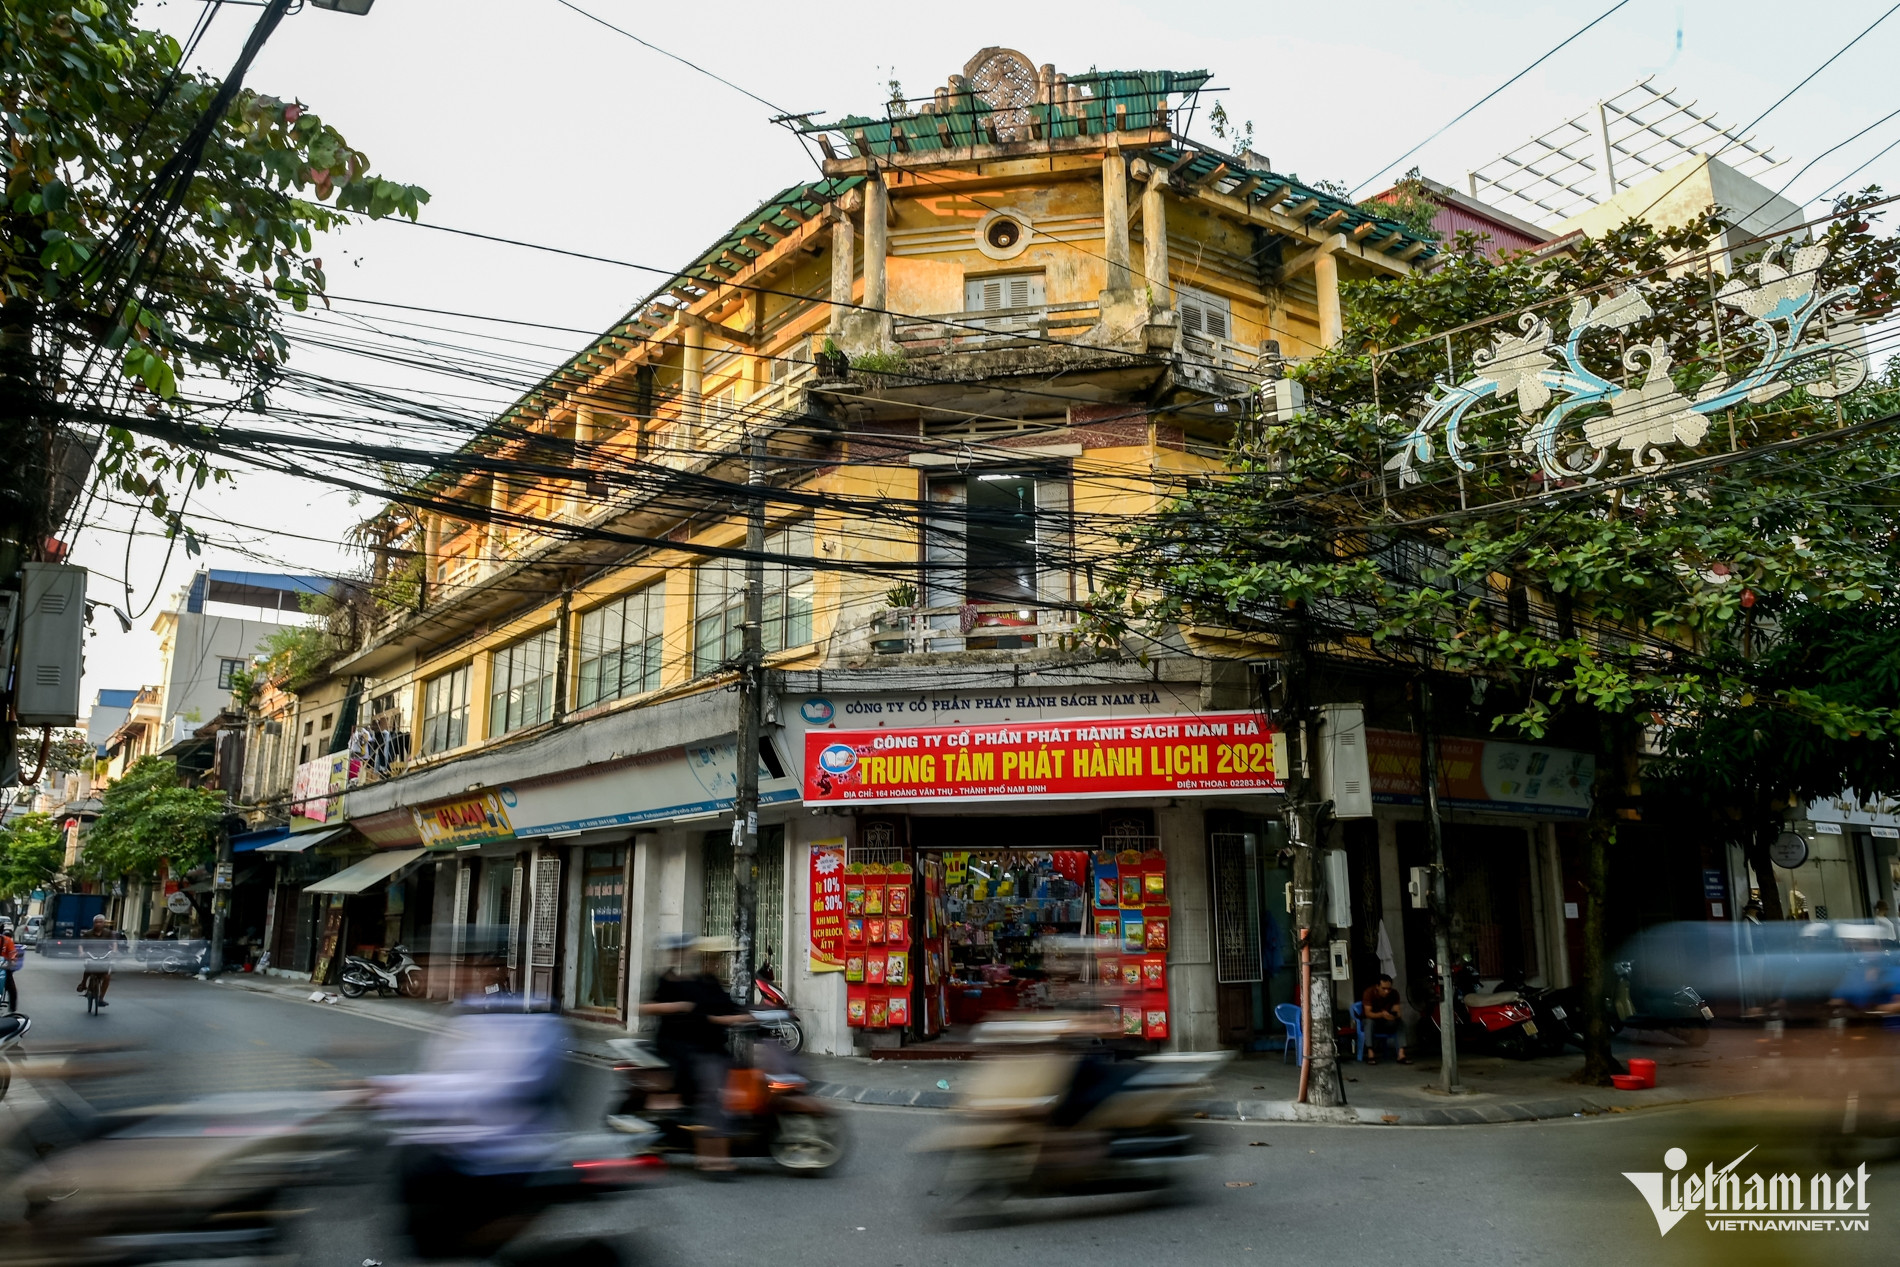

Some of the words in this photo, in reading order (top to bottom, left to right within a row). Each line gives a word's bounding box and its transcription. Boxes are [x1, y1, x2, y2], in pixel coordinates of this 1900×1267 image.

[846, 700, 882, 714] CÔNG
[886, 701, 904, 712] TY
[976, 695, 1012, 708] PHÁT
[1016, 694, 1056, 708] HÀNH
[1061, 693, 1097, 706] SÁCH
[1102, 694, 1134, 706] NAM
[1140, 690, 1160, 704] HÀ
[873, 734, 918, 750] CÔNG
[923, 734, 942, 748] TY
[947, 729, 970, 746] CỔ
[974, 728, 1022, 745] PHẦN
[1026, 727, 1071, 744] PHÁT
[1076, 725, 1125, 740] HÀNH
[1131, 724, 1179, 740] SÁCH
[1185, 724, 1227, 738] NAM
[1234, 720, 1259, 736] HÀ
[858, 754, 936, 784] TRUNG
[942, 747, 994, 782] TÂM
[1002, 744, 1066, 780] PHÁT
[1073, 742, 1143, 778] HÀNH
[1151, 744, 1208, 782] LỊCH
[1216, 742, 1275, 774] 2025
[844, 790, 857, 799] ĐỊA
[858, 788, 874, 798] CHỈ:
[876, 789, 888, 798] 164
[890, 787, 917, 797] HOÀNG
[918, 786, 935, 796] VĂN
[936, 787, 953, 796] THỤ
[959, 786, 986, 796] THÀNH
[988, 784, 1006, 794] PHỐ
[1007, 786, 1025, 794] NAM
[1026, 784, 1046, 794] ĐỊNH
[1177, 779, 1197, 789] ĐIỆN
[1199, 779, 1228, 788] THOẠI:
[824, 876, 840, 894] 10%
[824, 894, 842, 912] 30%
[827, 916, 840, 924] MUA
[826, 927, 844, 937] BLOCK
